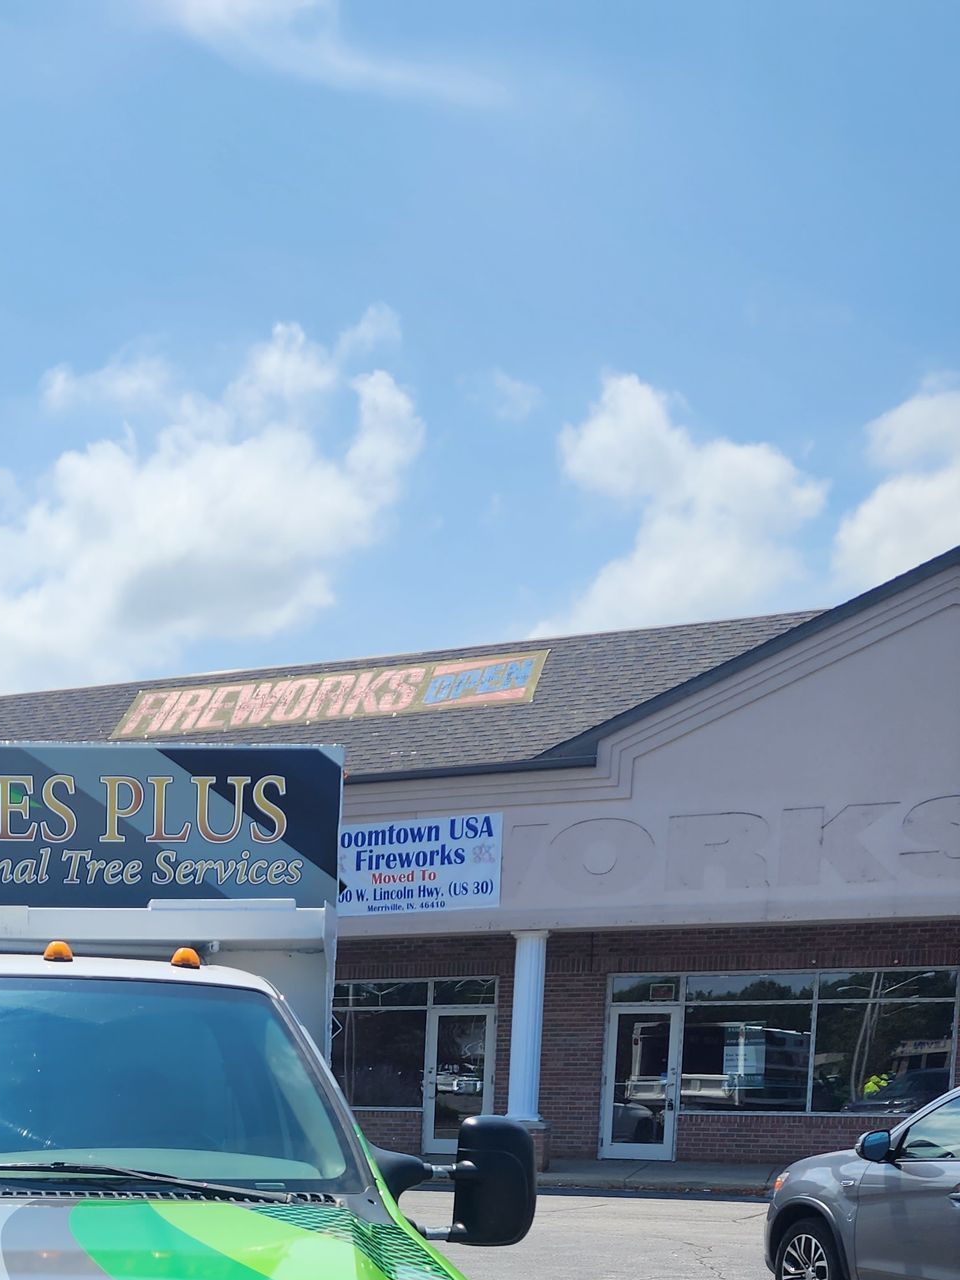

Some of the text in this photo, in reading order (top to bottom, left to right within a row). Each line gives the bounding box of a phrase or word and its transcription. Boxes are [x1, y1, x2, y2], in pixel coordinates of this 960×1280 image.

[121, 658, 535, 734] FIREWORKS OPEN
[99, 774, 288, 843] PLUS
[340, 816, 493, 848] oomtown USA
[61, 849, 143, 885] Tree
[152, 850, 303, 885] Services
[355, 844, 466, 871] Fireworks
[356, 888, 369, 902] W.
[373, 885, 414, 901] Lincoln
[418, 885, 444, 900] Hwy.
[448, 881, 468, 897] (US
[472, 879, 494, 896] 30)
[372, 870, 436, 885] Moved To
[419, 901, 446, 909] 46410
